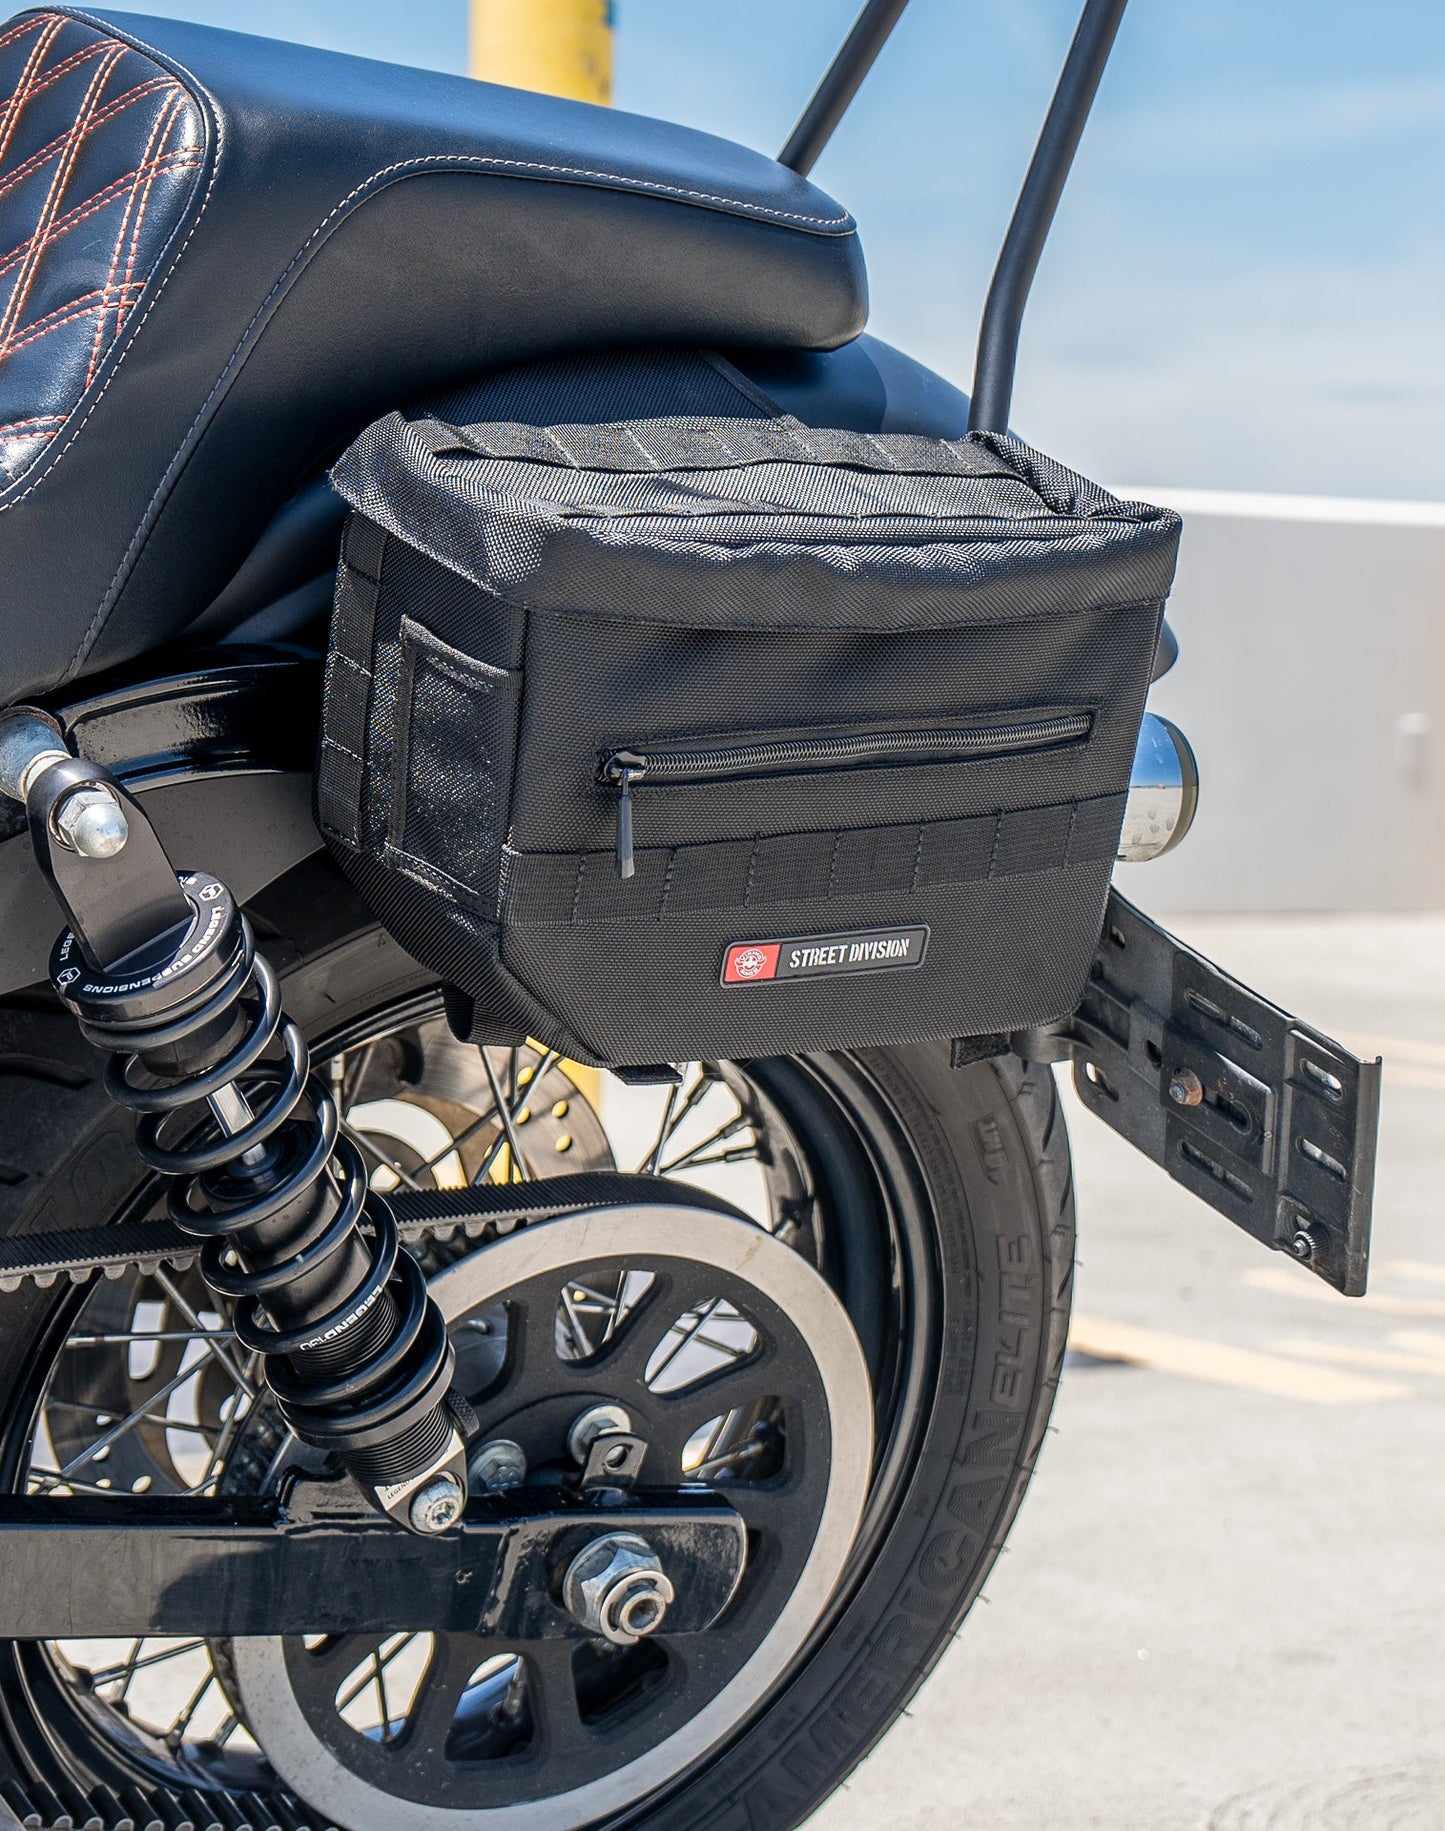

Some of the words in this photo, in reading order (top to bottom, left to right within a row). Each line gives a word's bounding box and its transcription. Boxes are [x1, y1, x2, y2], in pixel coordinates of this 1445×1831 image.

[60, 931, 76, 961] LEGE
[192, 905, 225, 954] LEGEND
[83, 953, 193, 993] SUSPENSIONS
[789, 943, 848, 969] STREET
[848, 938, 910, 962] DIVISION
[744, 1408, 1027, 1831] AMERICAN
[990, 1233, 1032, 1404] ELITE
